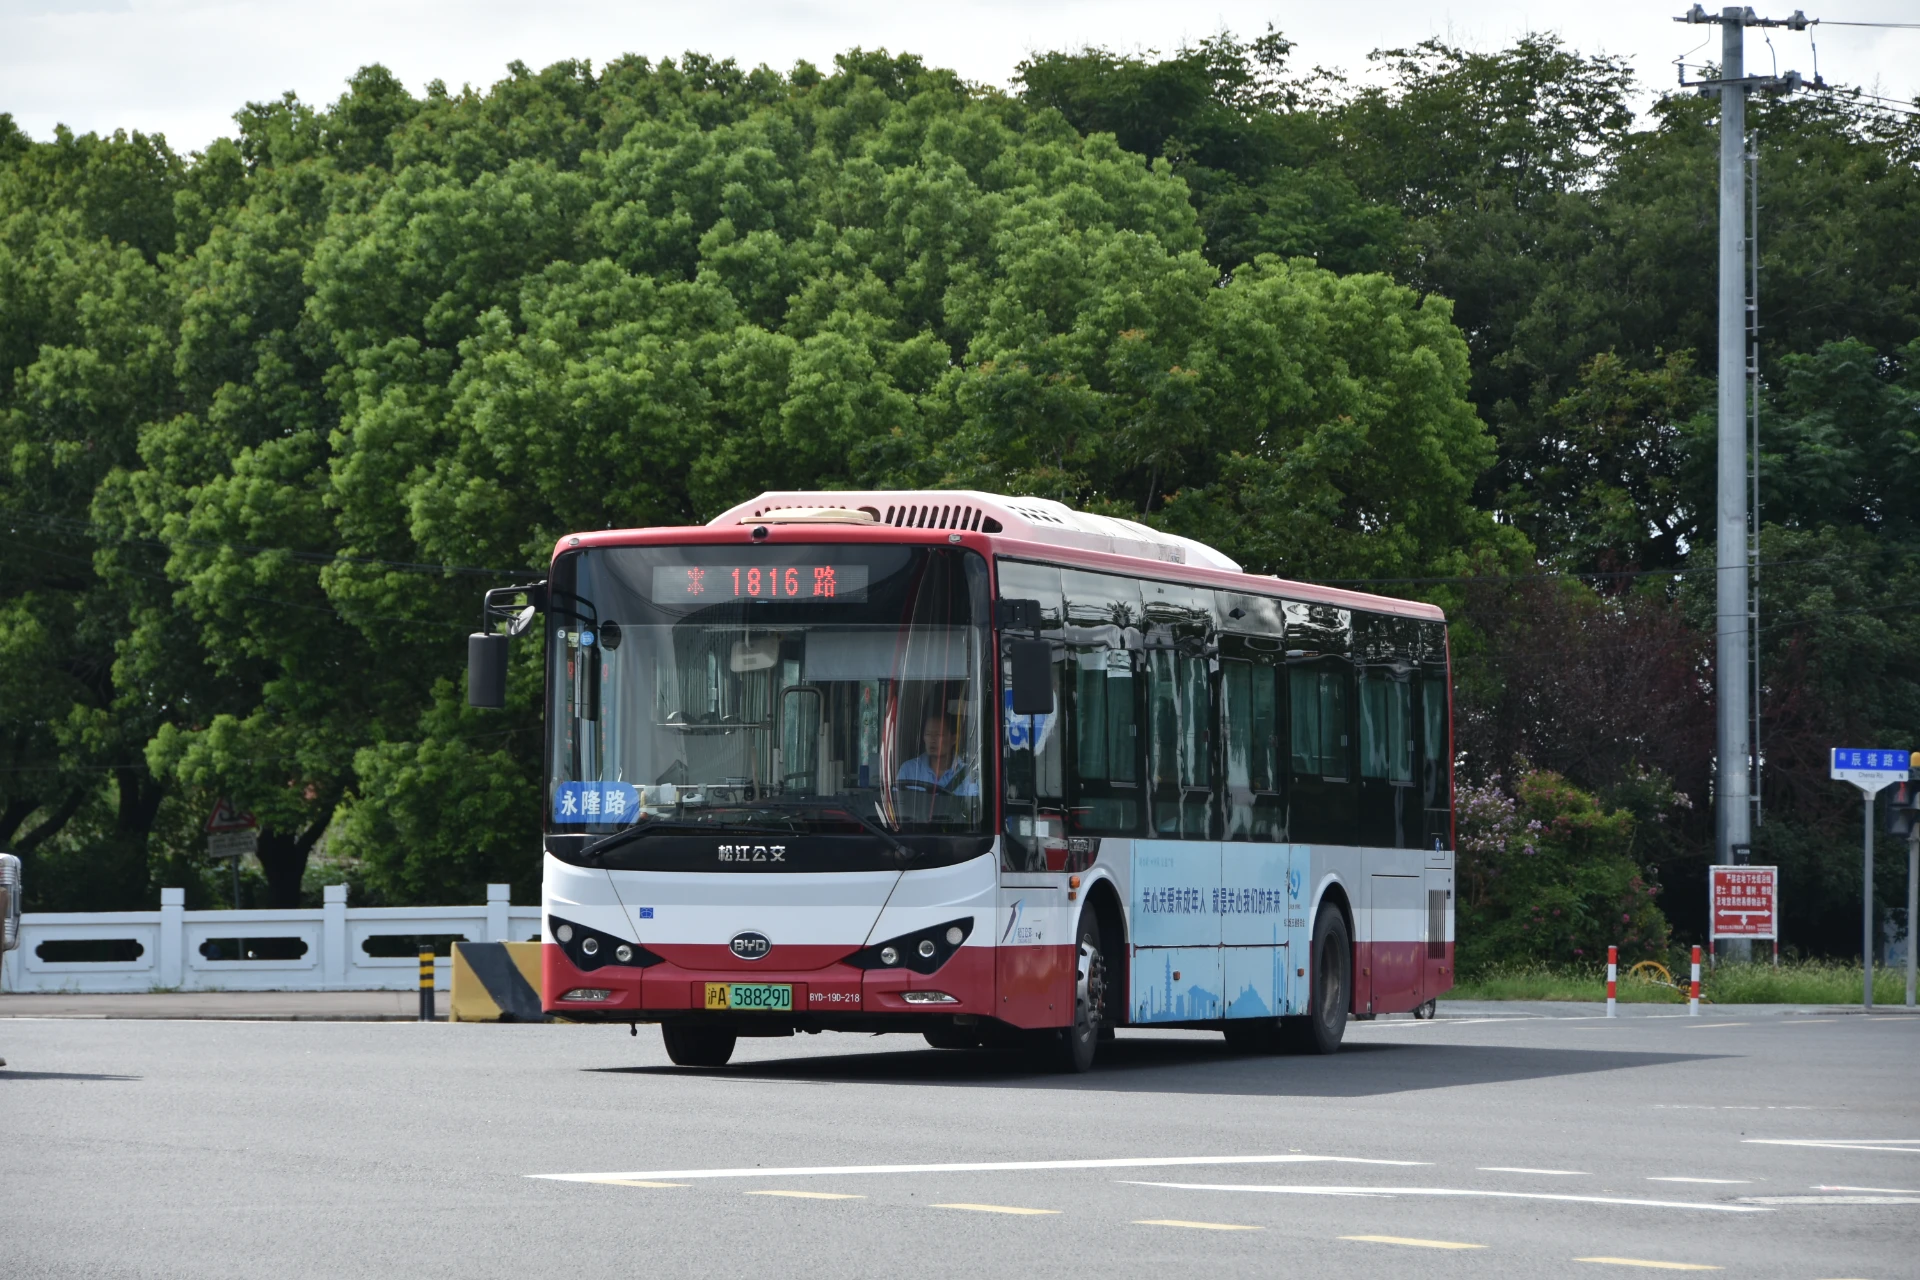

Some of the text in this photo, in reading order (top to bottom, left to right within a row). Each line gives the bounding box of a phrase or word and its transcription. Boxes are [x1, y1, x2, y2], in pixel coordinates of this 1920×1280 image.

[732, 566, 837, 597] 1816 路
[1851, 752, 1893, 767] 辰塔路
[561, 790, 626, 816] 永隆路
[718, 845, 786, 862] 松江公交
[1142, 887, 1281, 914] 关心关爱未成年人 就是关心我们的未来
[734, 939, 767, 951] BYD
[809, 992, 861, 1003] BYD-19D-218
